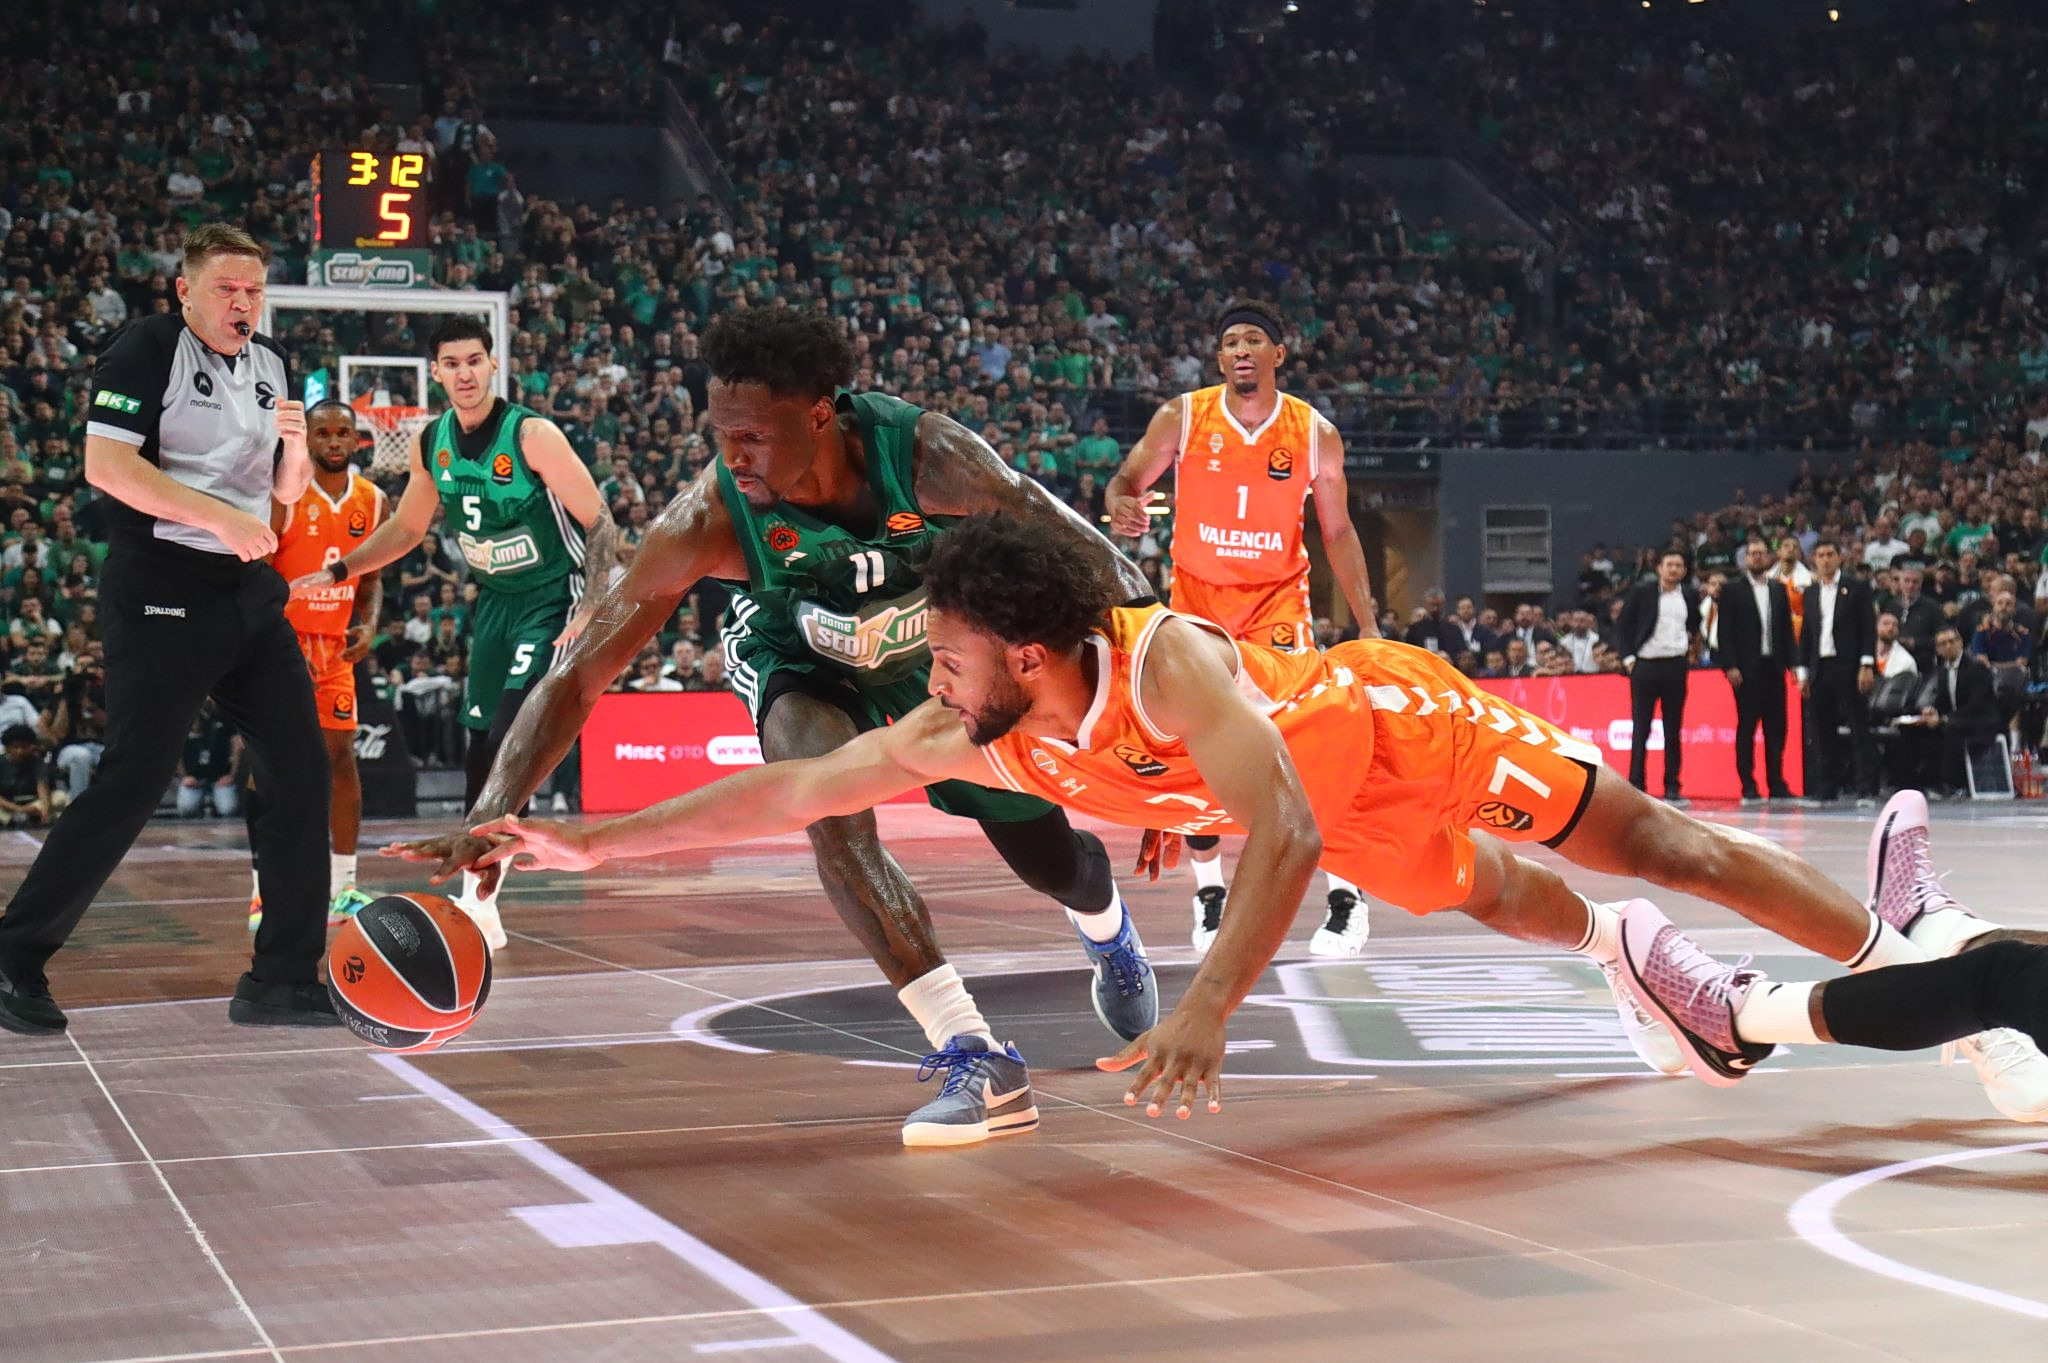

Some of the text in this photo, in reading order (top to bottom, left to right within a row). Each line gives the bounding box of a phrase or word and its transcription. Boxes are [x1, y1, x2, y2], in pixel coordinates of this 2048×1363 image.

[348, 152, 424, 188] 3:12
[378, 192, 412, 241] 5
[96, 391, 140, 413] BKT
[462, 495, 482, 532] 5
[1236, 485, 1249, 520] 1
[1198, 522, 1284, 551] VALENCIA
[1215, 547, 1262, 560] BASKET
[848, 550, 885, 594] 11
[306, 584, 355, 601] LENCIA
[144, 604, 186, 618] SPALDING
[510, 643, 536, 676] 5
[1487, 755, 1552, 800] 7
